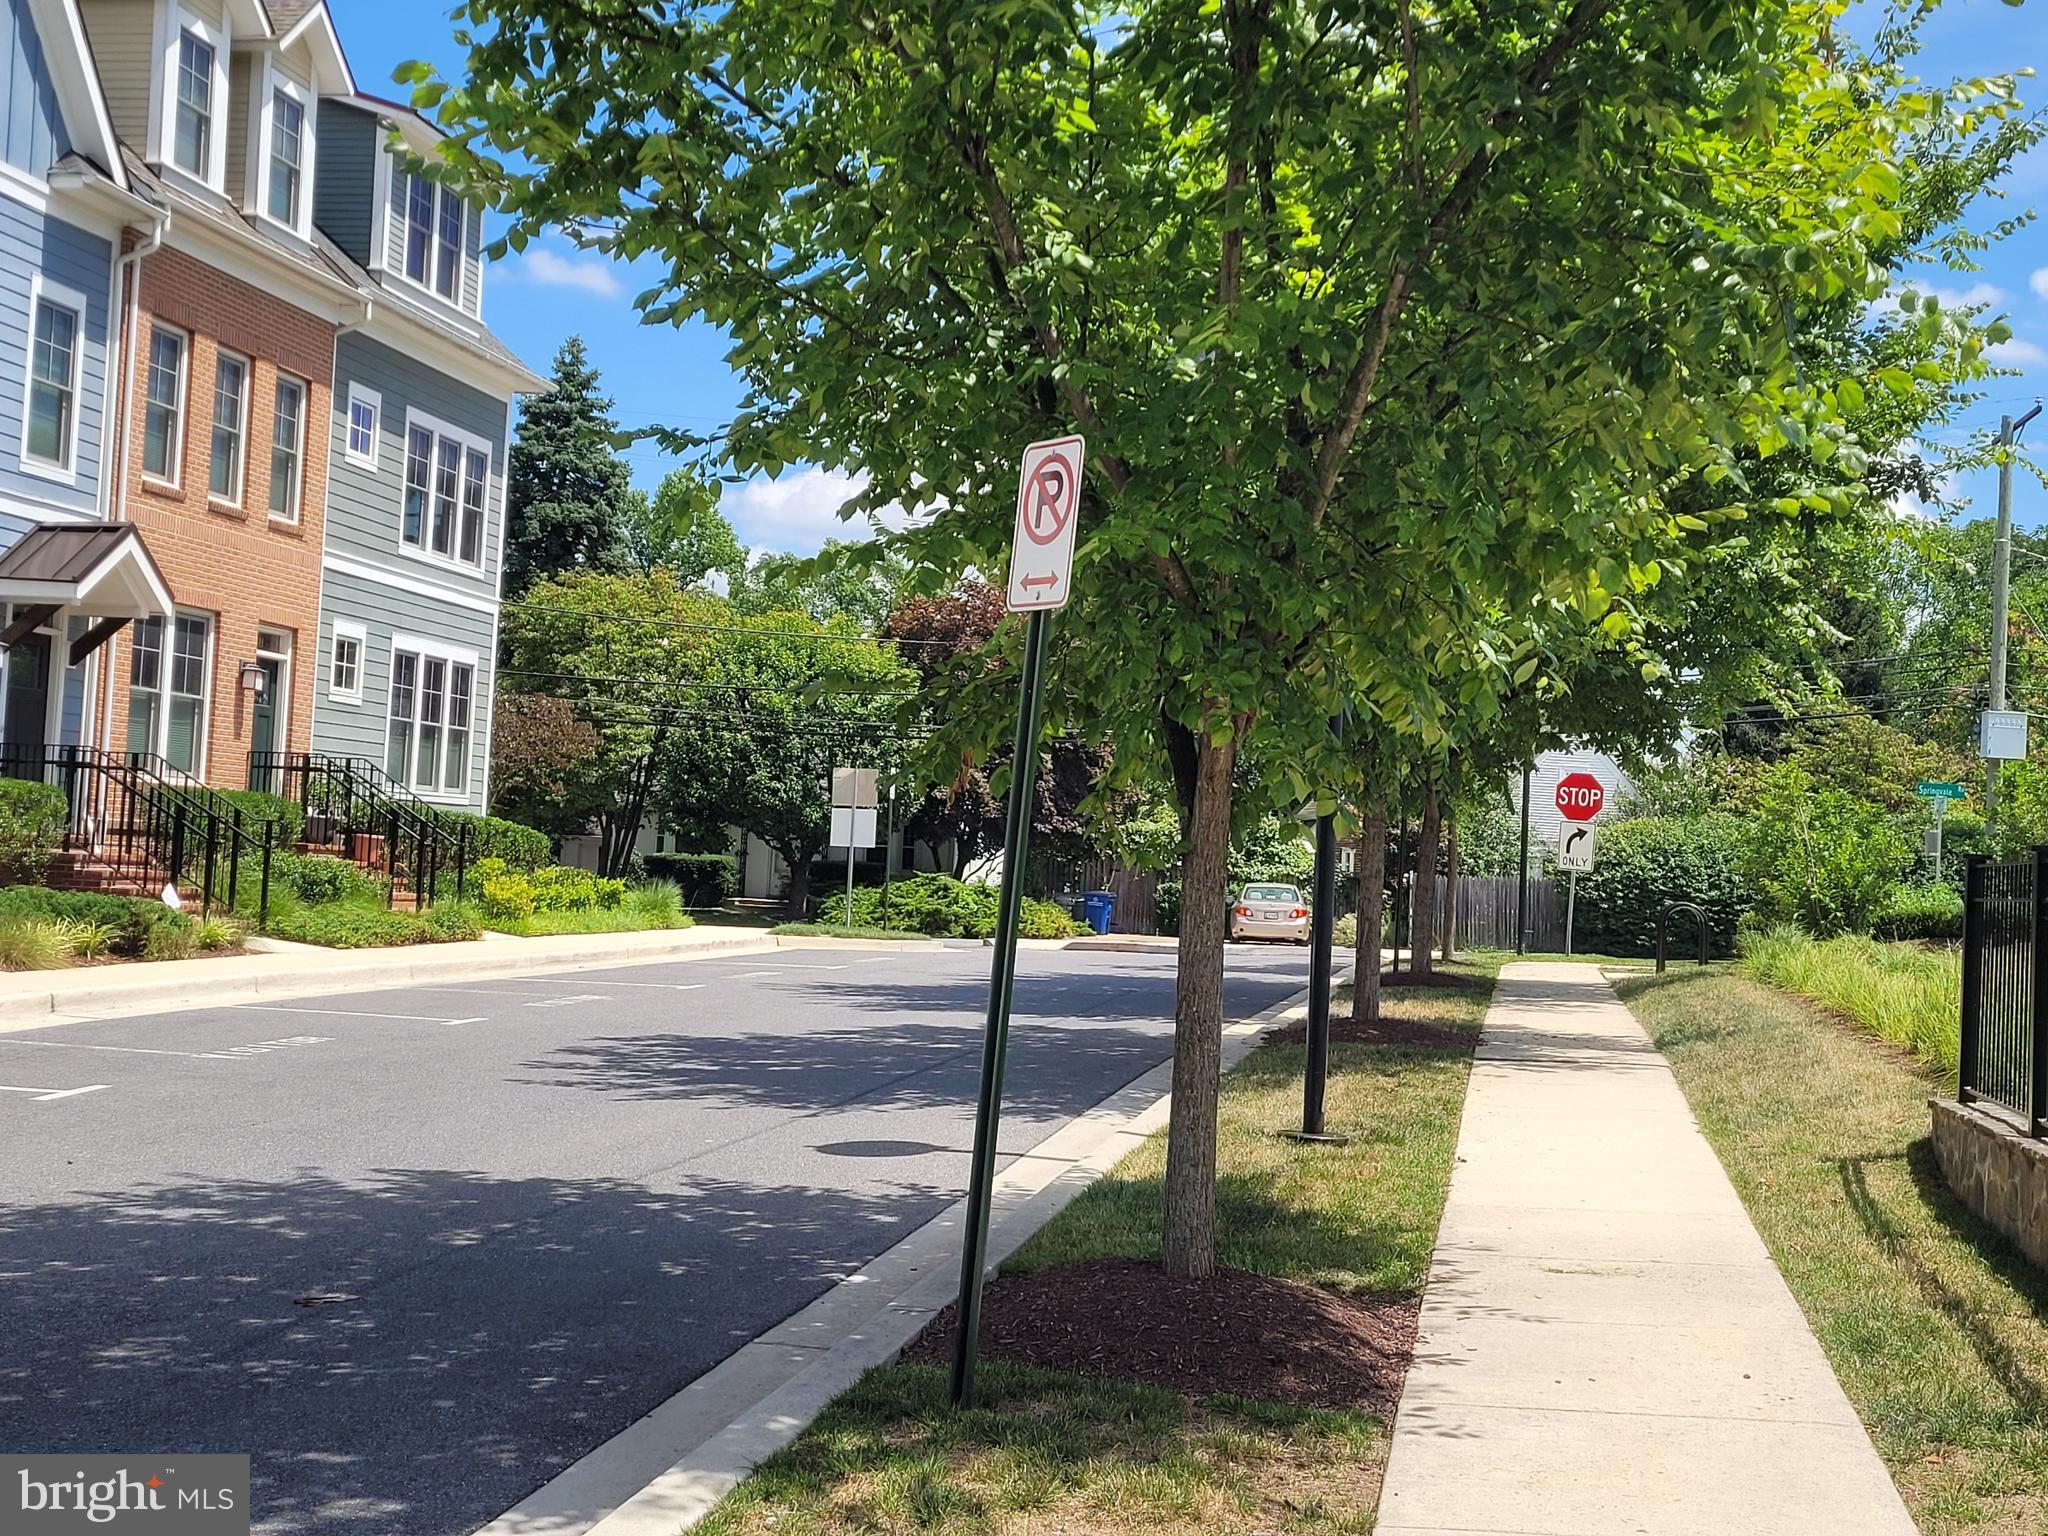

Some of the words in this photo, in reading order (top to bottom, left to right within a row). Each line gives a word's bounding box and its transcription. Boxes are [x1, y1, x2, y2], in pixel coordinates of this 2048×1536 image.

[1558, 786, 1601, 808] STOP
[1918, 784, 1953, 797] Springvale
[1562, 856, 1589, 867] ONLY
